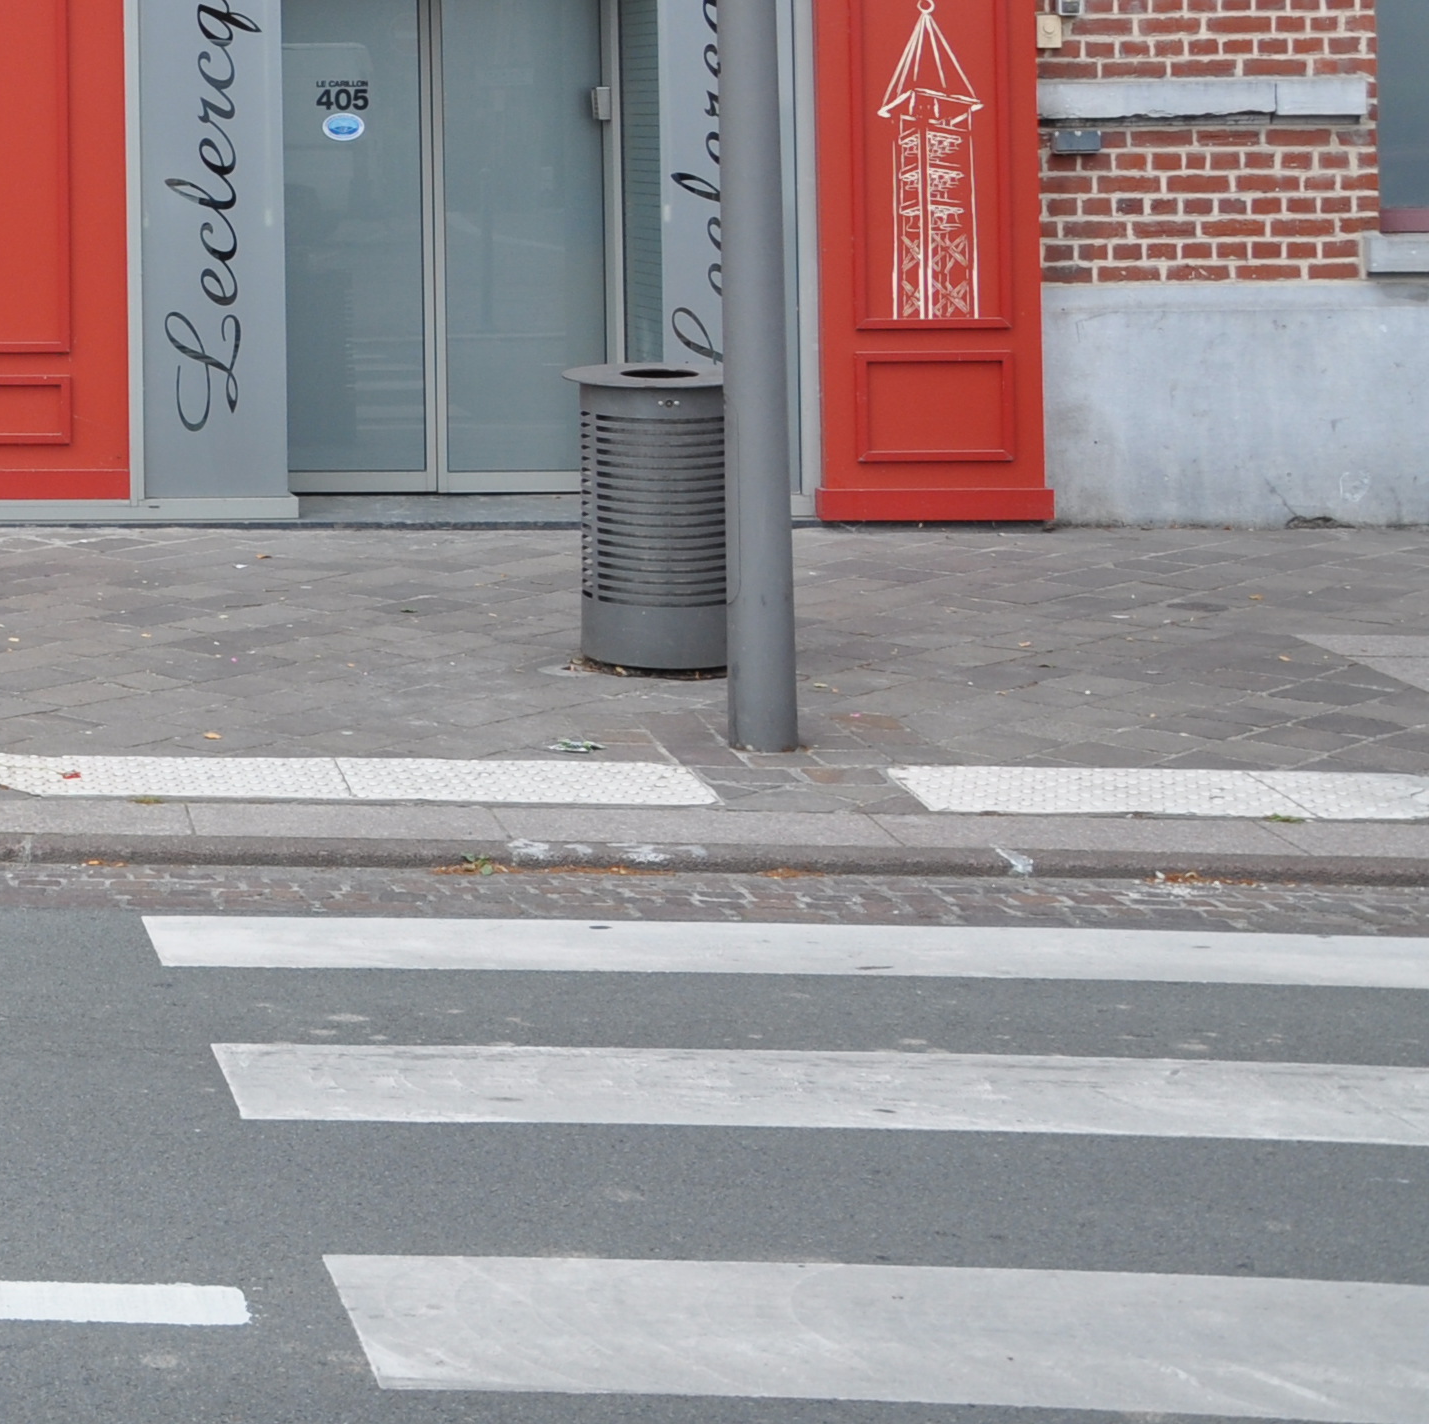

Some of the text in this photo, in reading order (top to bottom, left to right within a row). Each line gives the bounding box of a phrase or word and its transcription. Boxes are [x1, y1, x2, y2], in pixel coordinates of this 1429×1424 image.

[316, 80, 369, 88] LE CARILLON
[316, 88, 369, 111] 405
